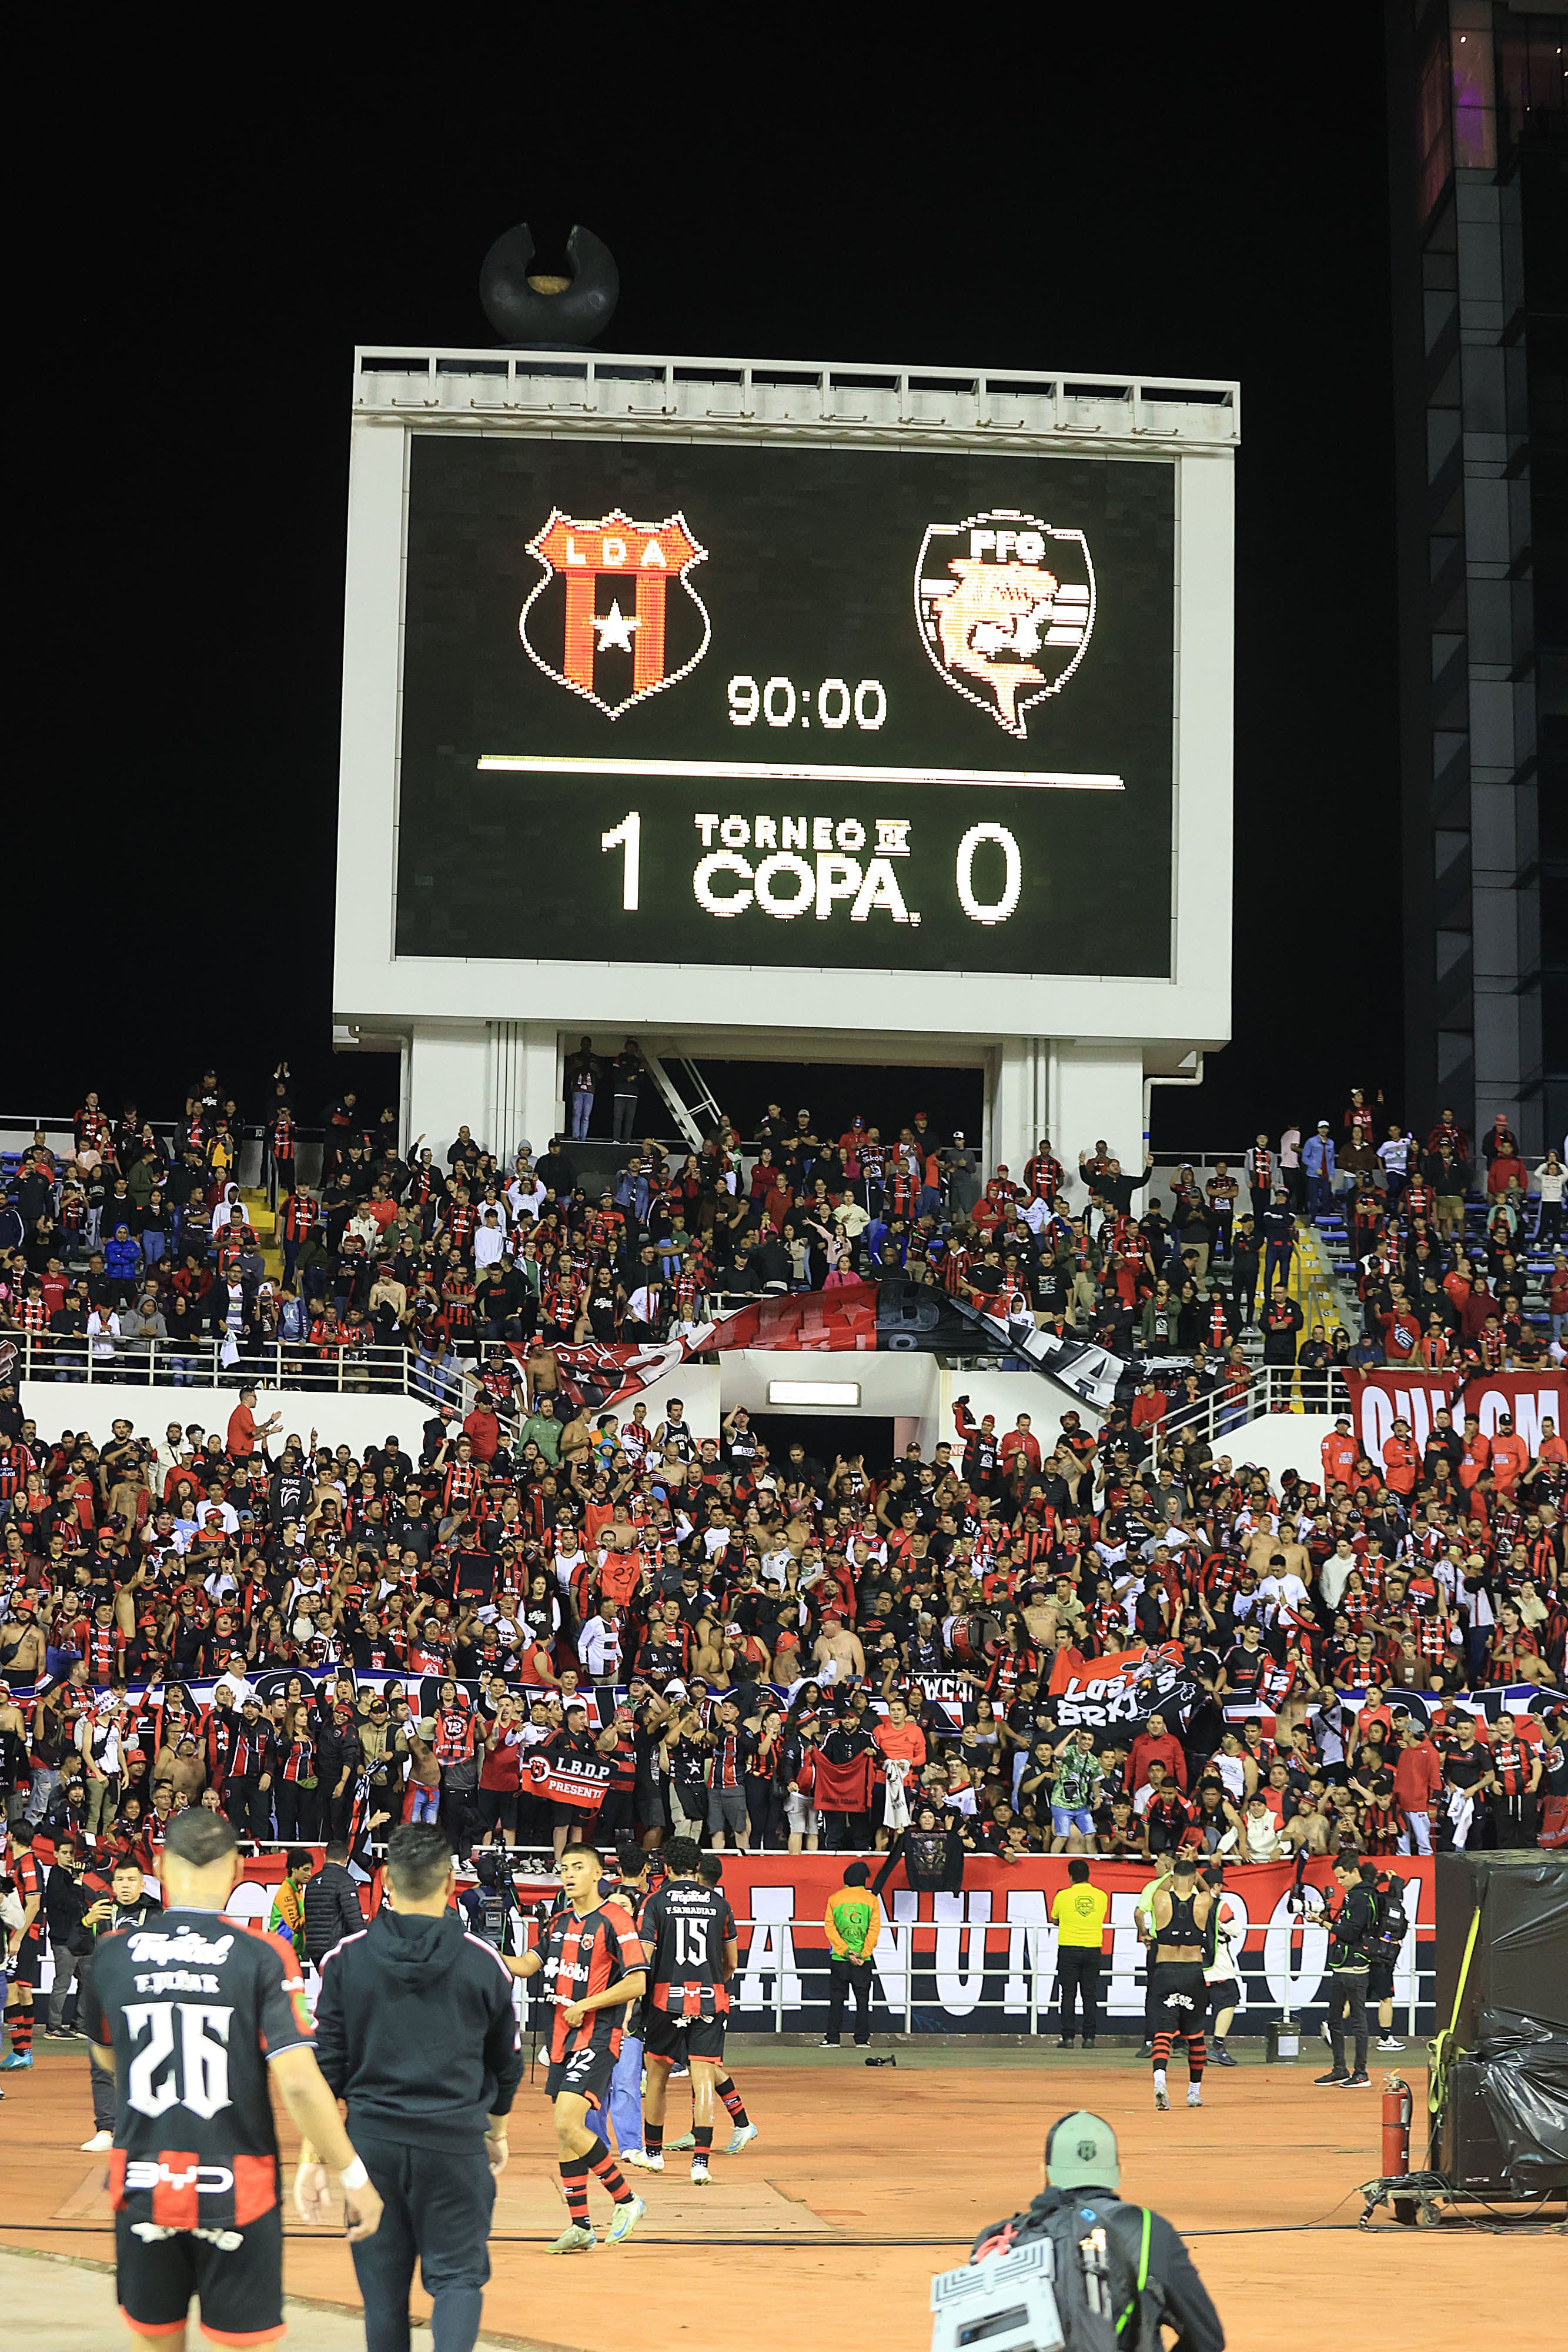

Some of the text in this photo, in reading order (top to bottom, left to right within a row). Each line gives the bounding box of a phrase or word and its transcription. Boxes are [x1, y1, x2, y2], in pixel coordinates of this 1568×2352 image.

[566, 536, 667, 567] LDA
[727, 675, 887, 730] 90:00
[694, 813, 867, 851] TORNEO
[601, 811, 638, 910] 1
[955, 822, 1022, 925] 0
[613, 1566, 634, 1584] 23
[1064, 1675, 1128, 1702] LOS
[447, 1721, 462, 1733] 12
[666, 1890, 711, 1905] Tropical
[674, 1917, 710, 1967] 15
[559, 1959, 589, 1982] kölbi
[668, 1986, 715, 1998] BYD
[121, 2000, 235, 2120] 26
[125, 2161, 234, 2193] BYD
